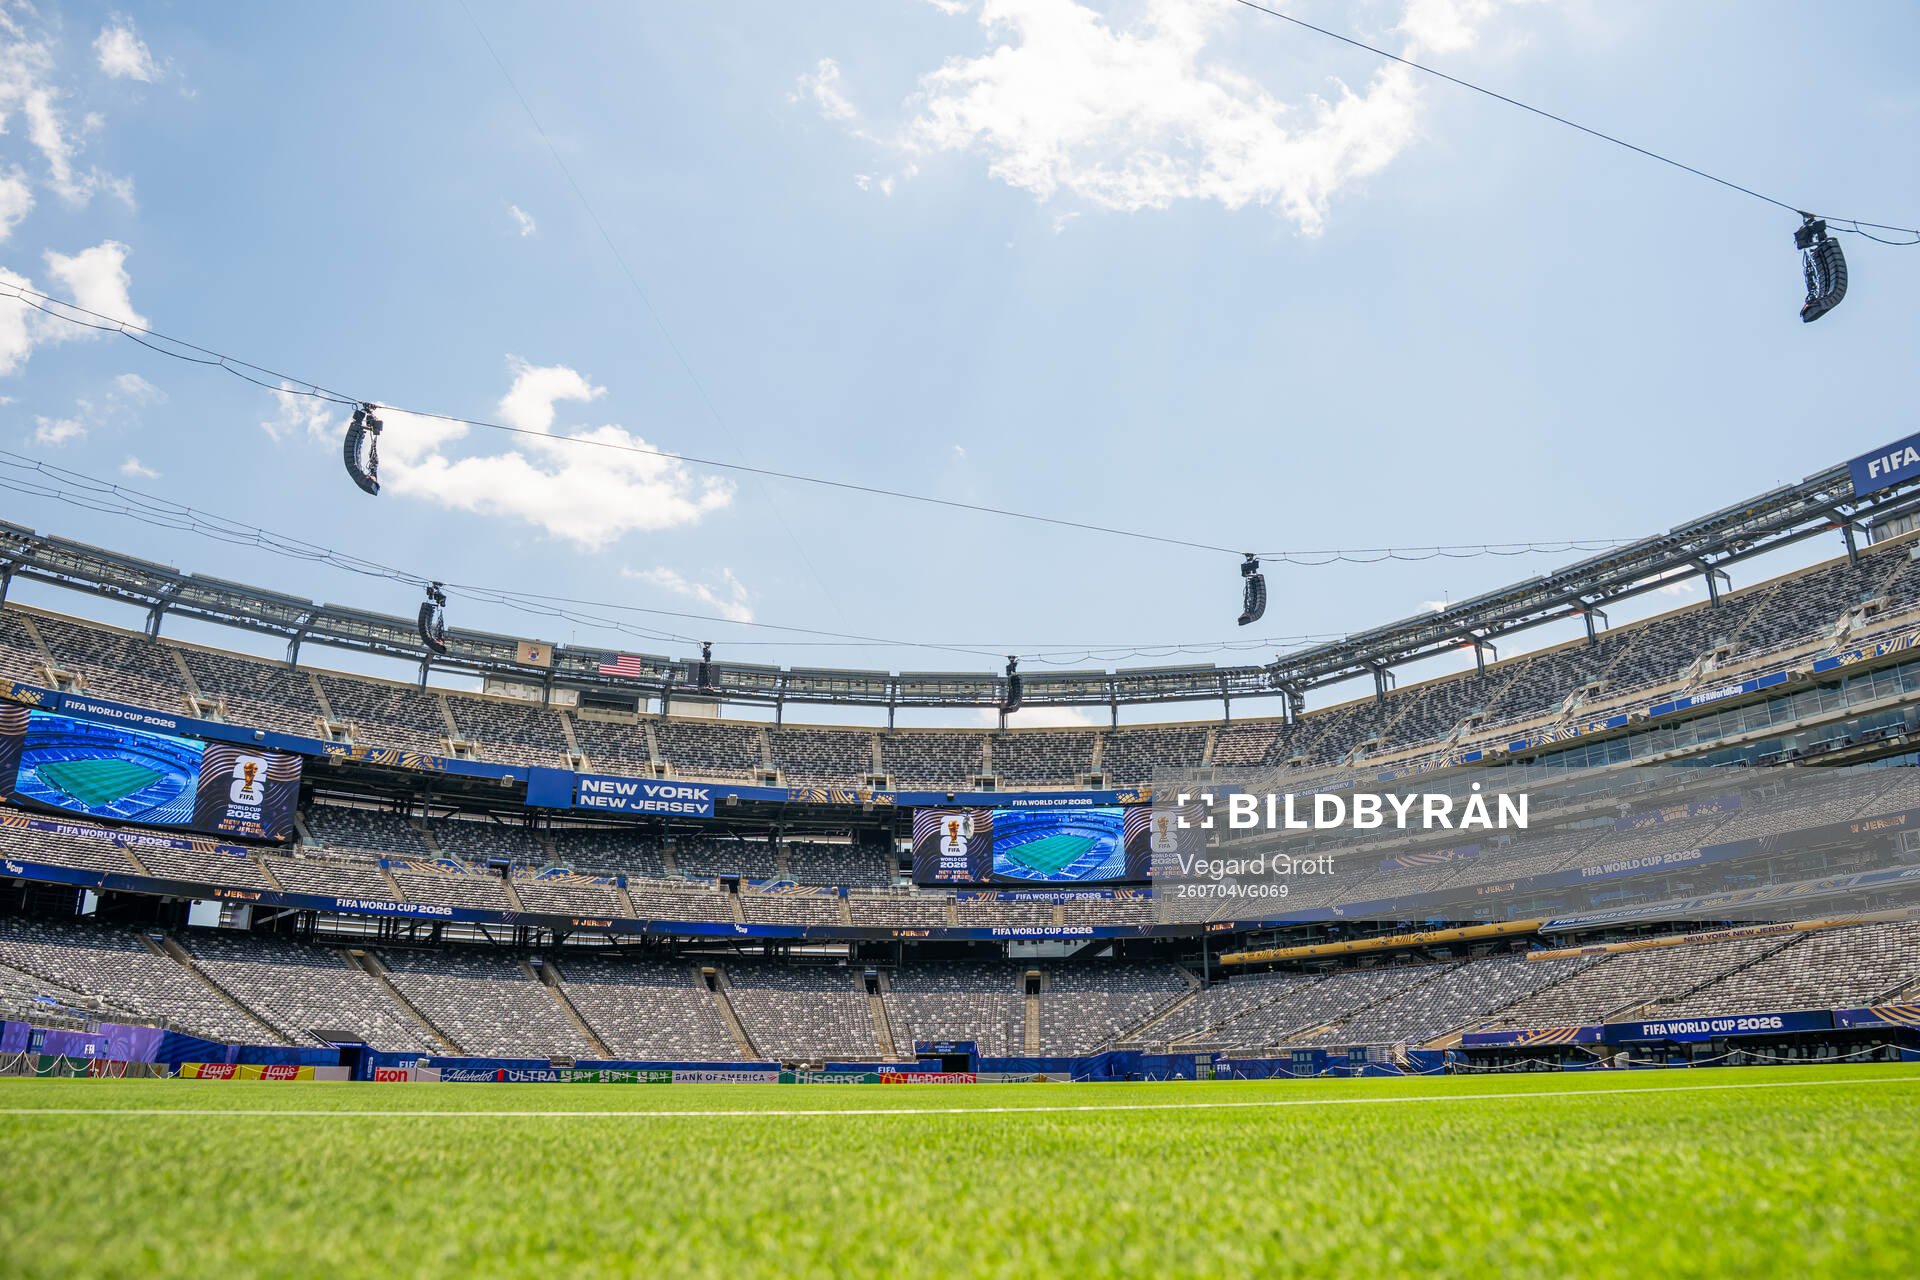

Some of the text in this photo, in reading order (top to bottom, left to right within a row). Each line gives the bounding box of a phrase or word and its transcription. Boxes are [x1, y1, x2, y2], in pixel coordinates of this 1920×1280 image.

[1868, 446, 1920, 479] FIFA
[1690, 685, 1743, 705] #FIFAWorldCup
[65, 700, 176, 728] FIFA WORLD CUP 2026
[582, 780, 710, 800] NEW YORK
[580, 795, 710, 814] NEW JERSEY
[226, 810, 260, 820] 2026
[56, 825, 79, 836] FIFA
[80, 828, 116, 840] WORLD
[117, 833, 138, 842] CUP
[138, 836, 172, 848] 2026
[1582, 849, 1702, 877] FIFA WORLD CUP 2026
[336, 898, 453, 915] FIFA WORLD CUP 2026
[1684, 924, 1795, 943] NEW YORK NEW JERSEY
[1643, 1016, 1782, 1035] FIFA WORLD CUP 2026
[202, 1064, 232, 1078] Lay's
[265, 1065, 295, 1080] Lay's
[376, 1067, 407, 1082] izon
[442, 1069, 557, 1082] Michelob ULTRA
[1217, 1064, 1231, 1072] FIFA
[795, 1072, 864, 1084] Hisense
[907, 1073, 974, 1084] McDonald's
